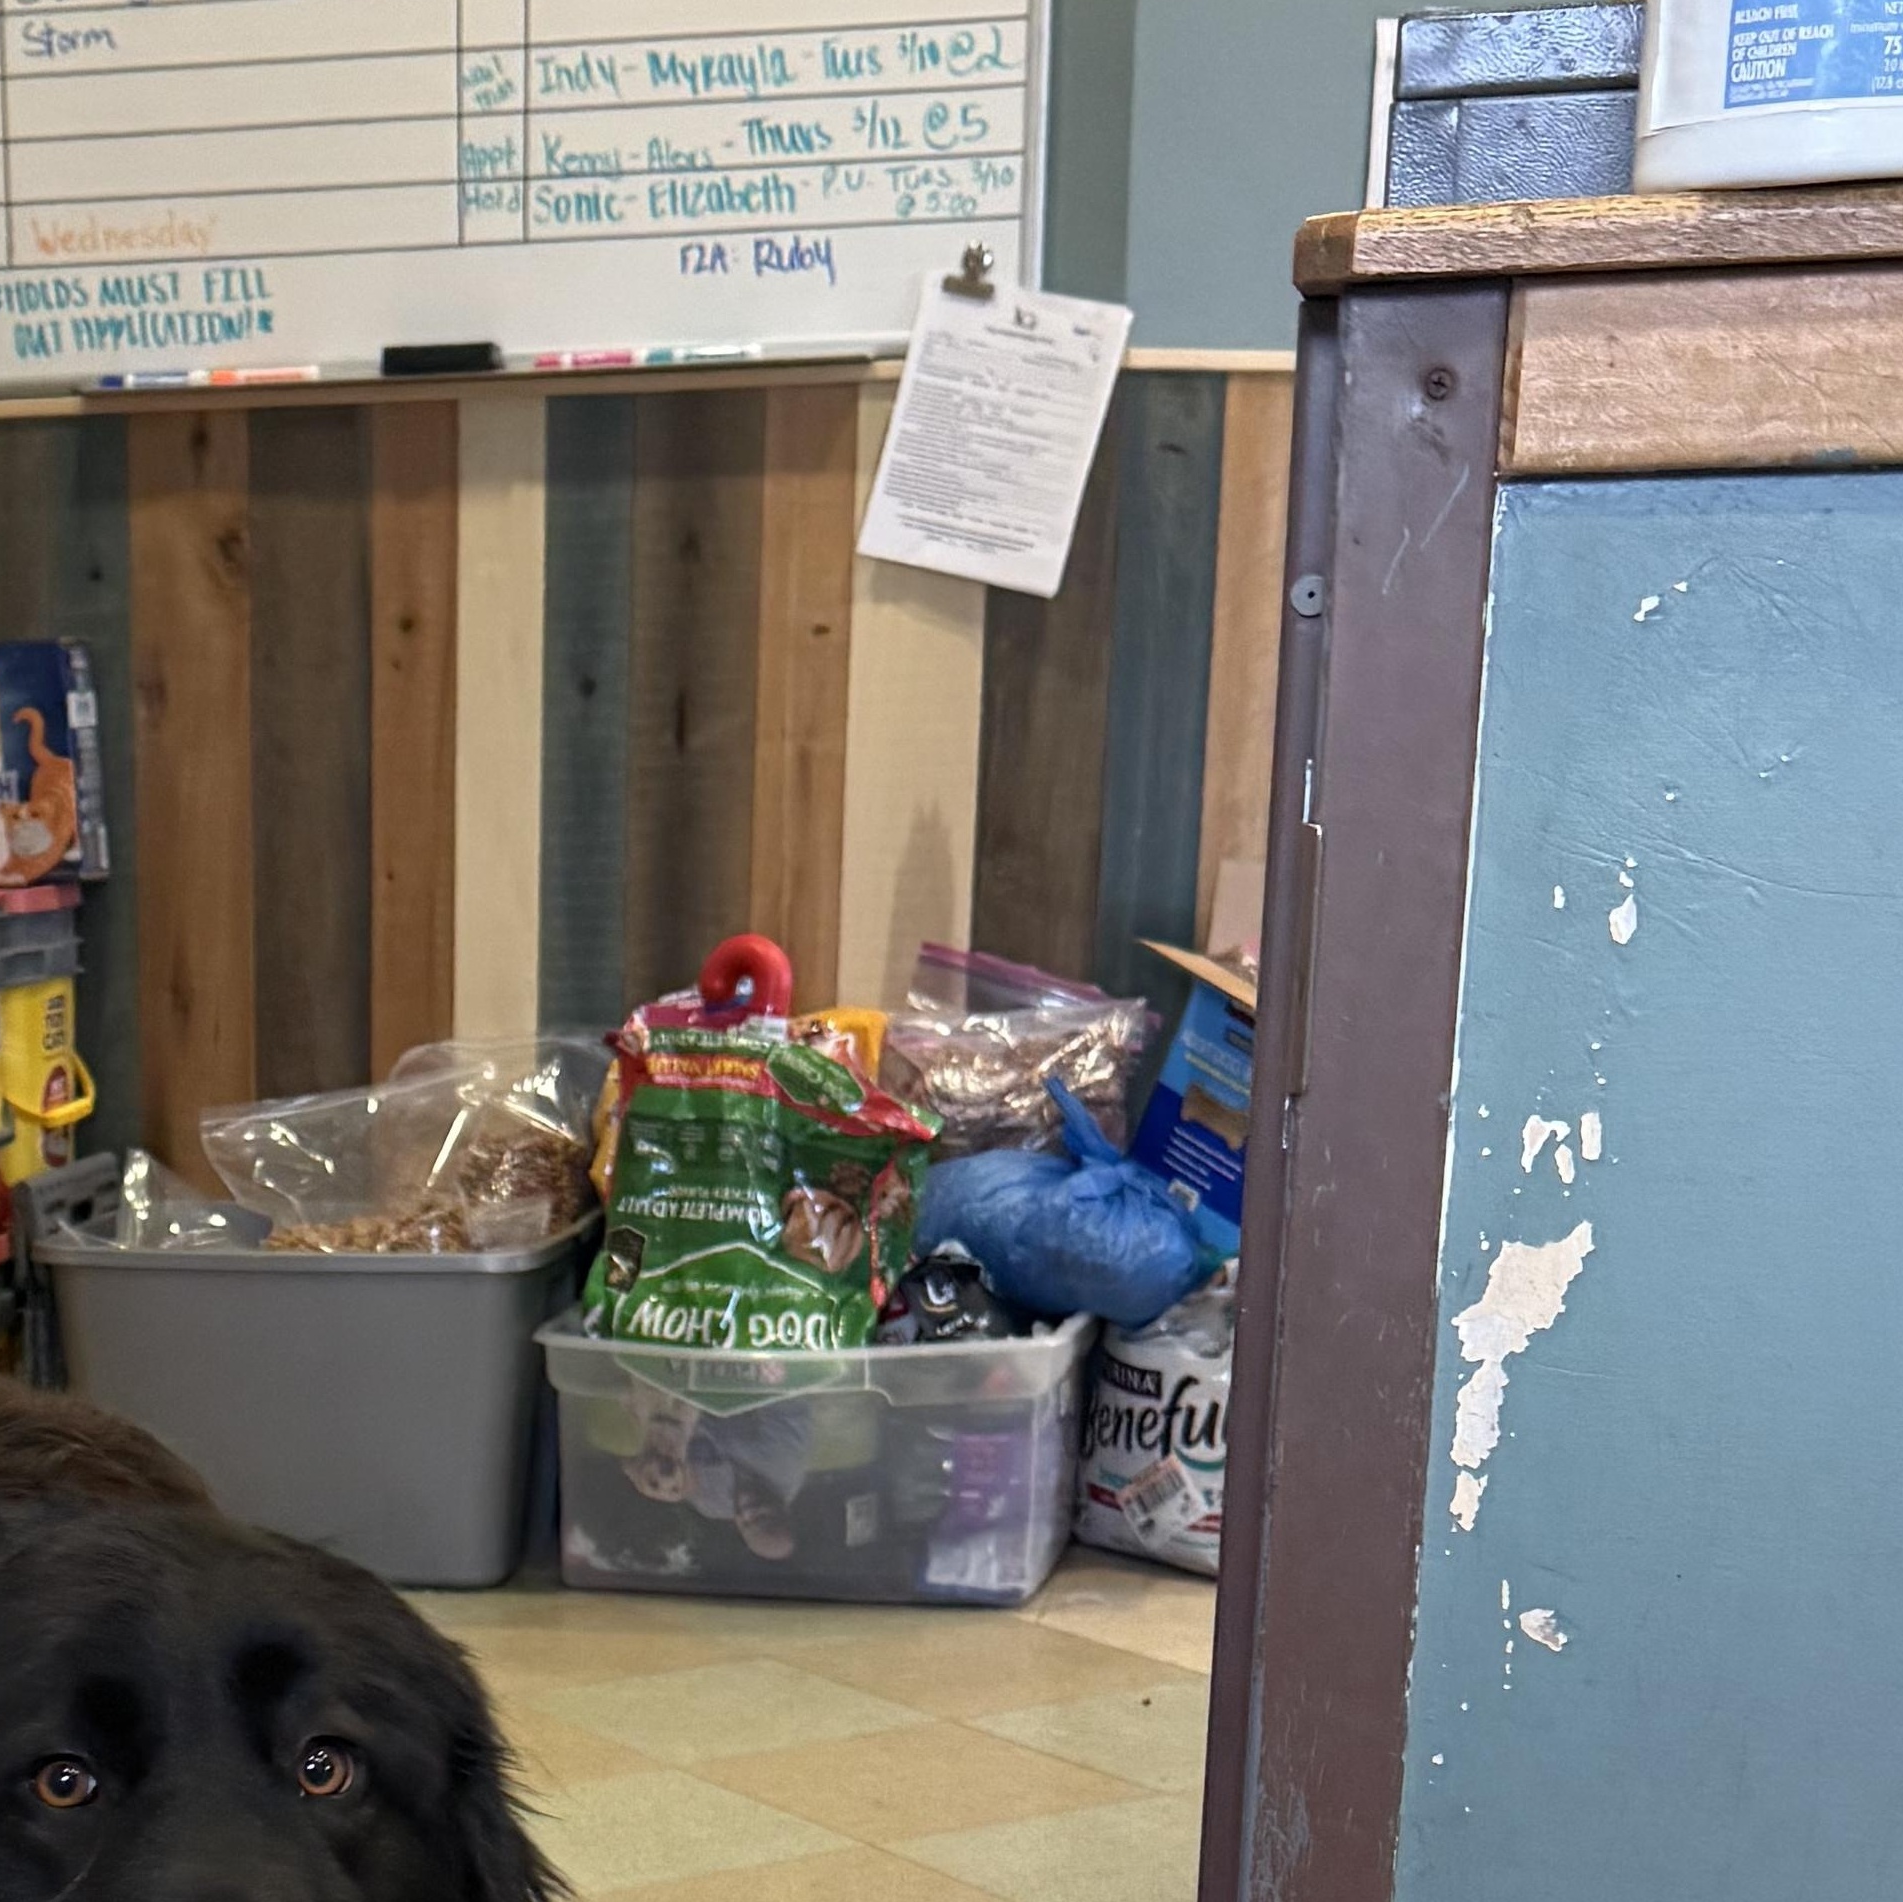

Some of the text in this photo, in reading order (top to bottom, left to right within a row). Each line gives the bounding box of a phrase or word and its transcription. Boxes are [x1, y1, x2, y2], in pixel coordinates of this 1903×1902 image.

[21, 20, 116, 59] Storm
[1731, 58, 1787, 83] CAUTION
[753, 235, 837, 287] Ruby
[99, 271, 180, 308] MUST
[203, 267, 272, 304] FILL
[625, 1299, 827, 1352] DOG CHOW
